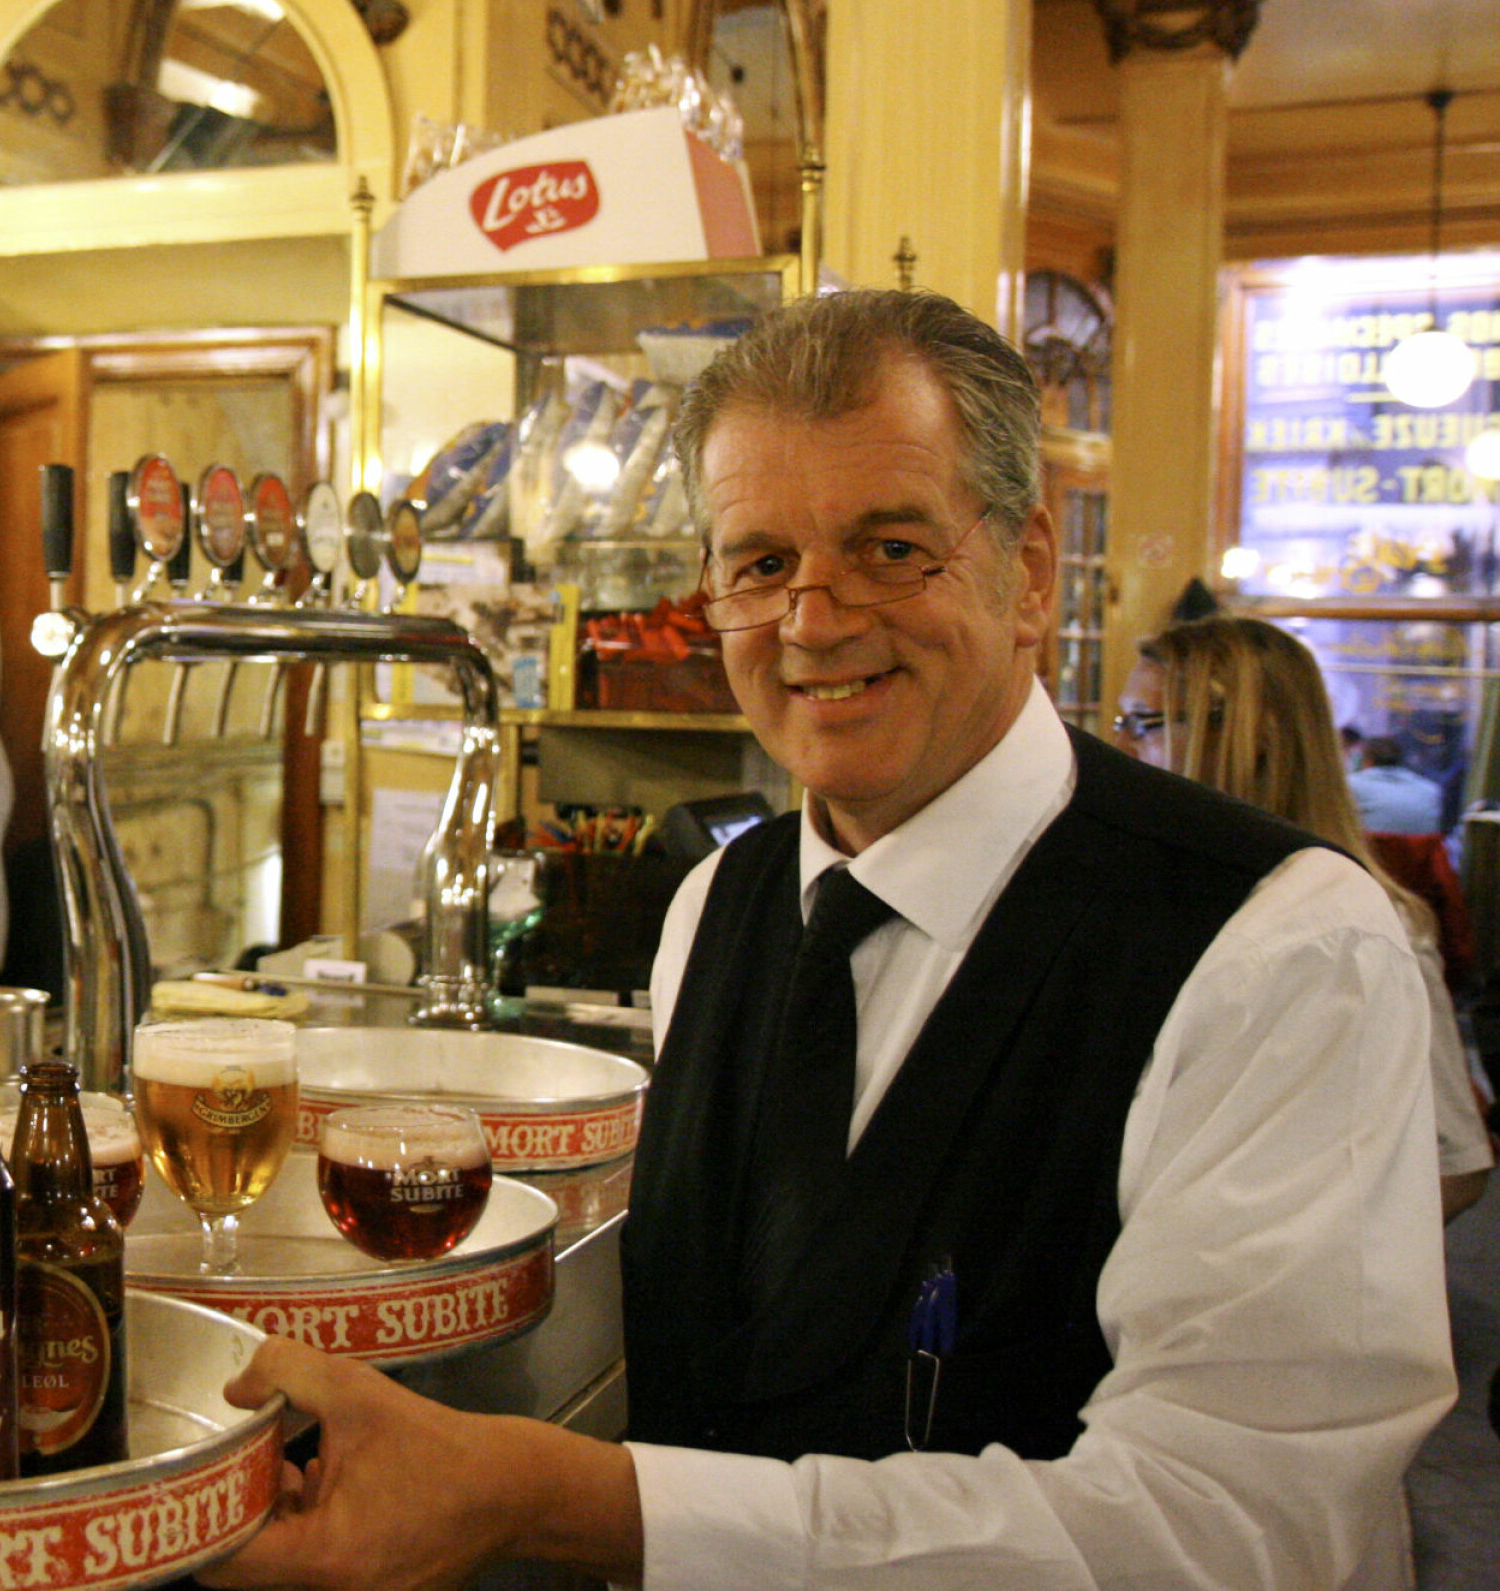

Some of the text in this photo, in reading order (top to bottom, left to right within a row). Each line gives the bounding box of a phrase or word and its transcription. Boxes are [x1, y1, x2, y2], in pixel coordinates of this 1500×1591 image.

[482, 168, 588, 232] Lotus
[483, 1123, 576, 1156] MORT
[390, 1184, 465, 1202] SUBITE
[393, 1167, 462, 1187] MORT
[375, 1276, 509, 1344] SUBITE
[84, 1469, 246, 1577] SUBITE
